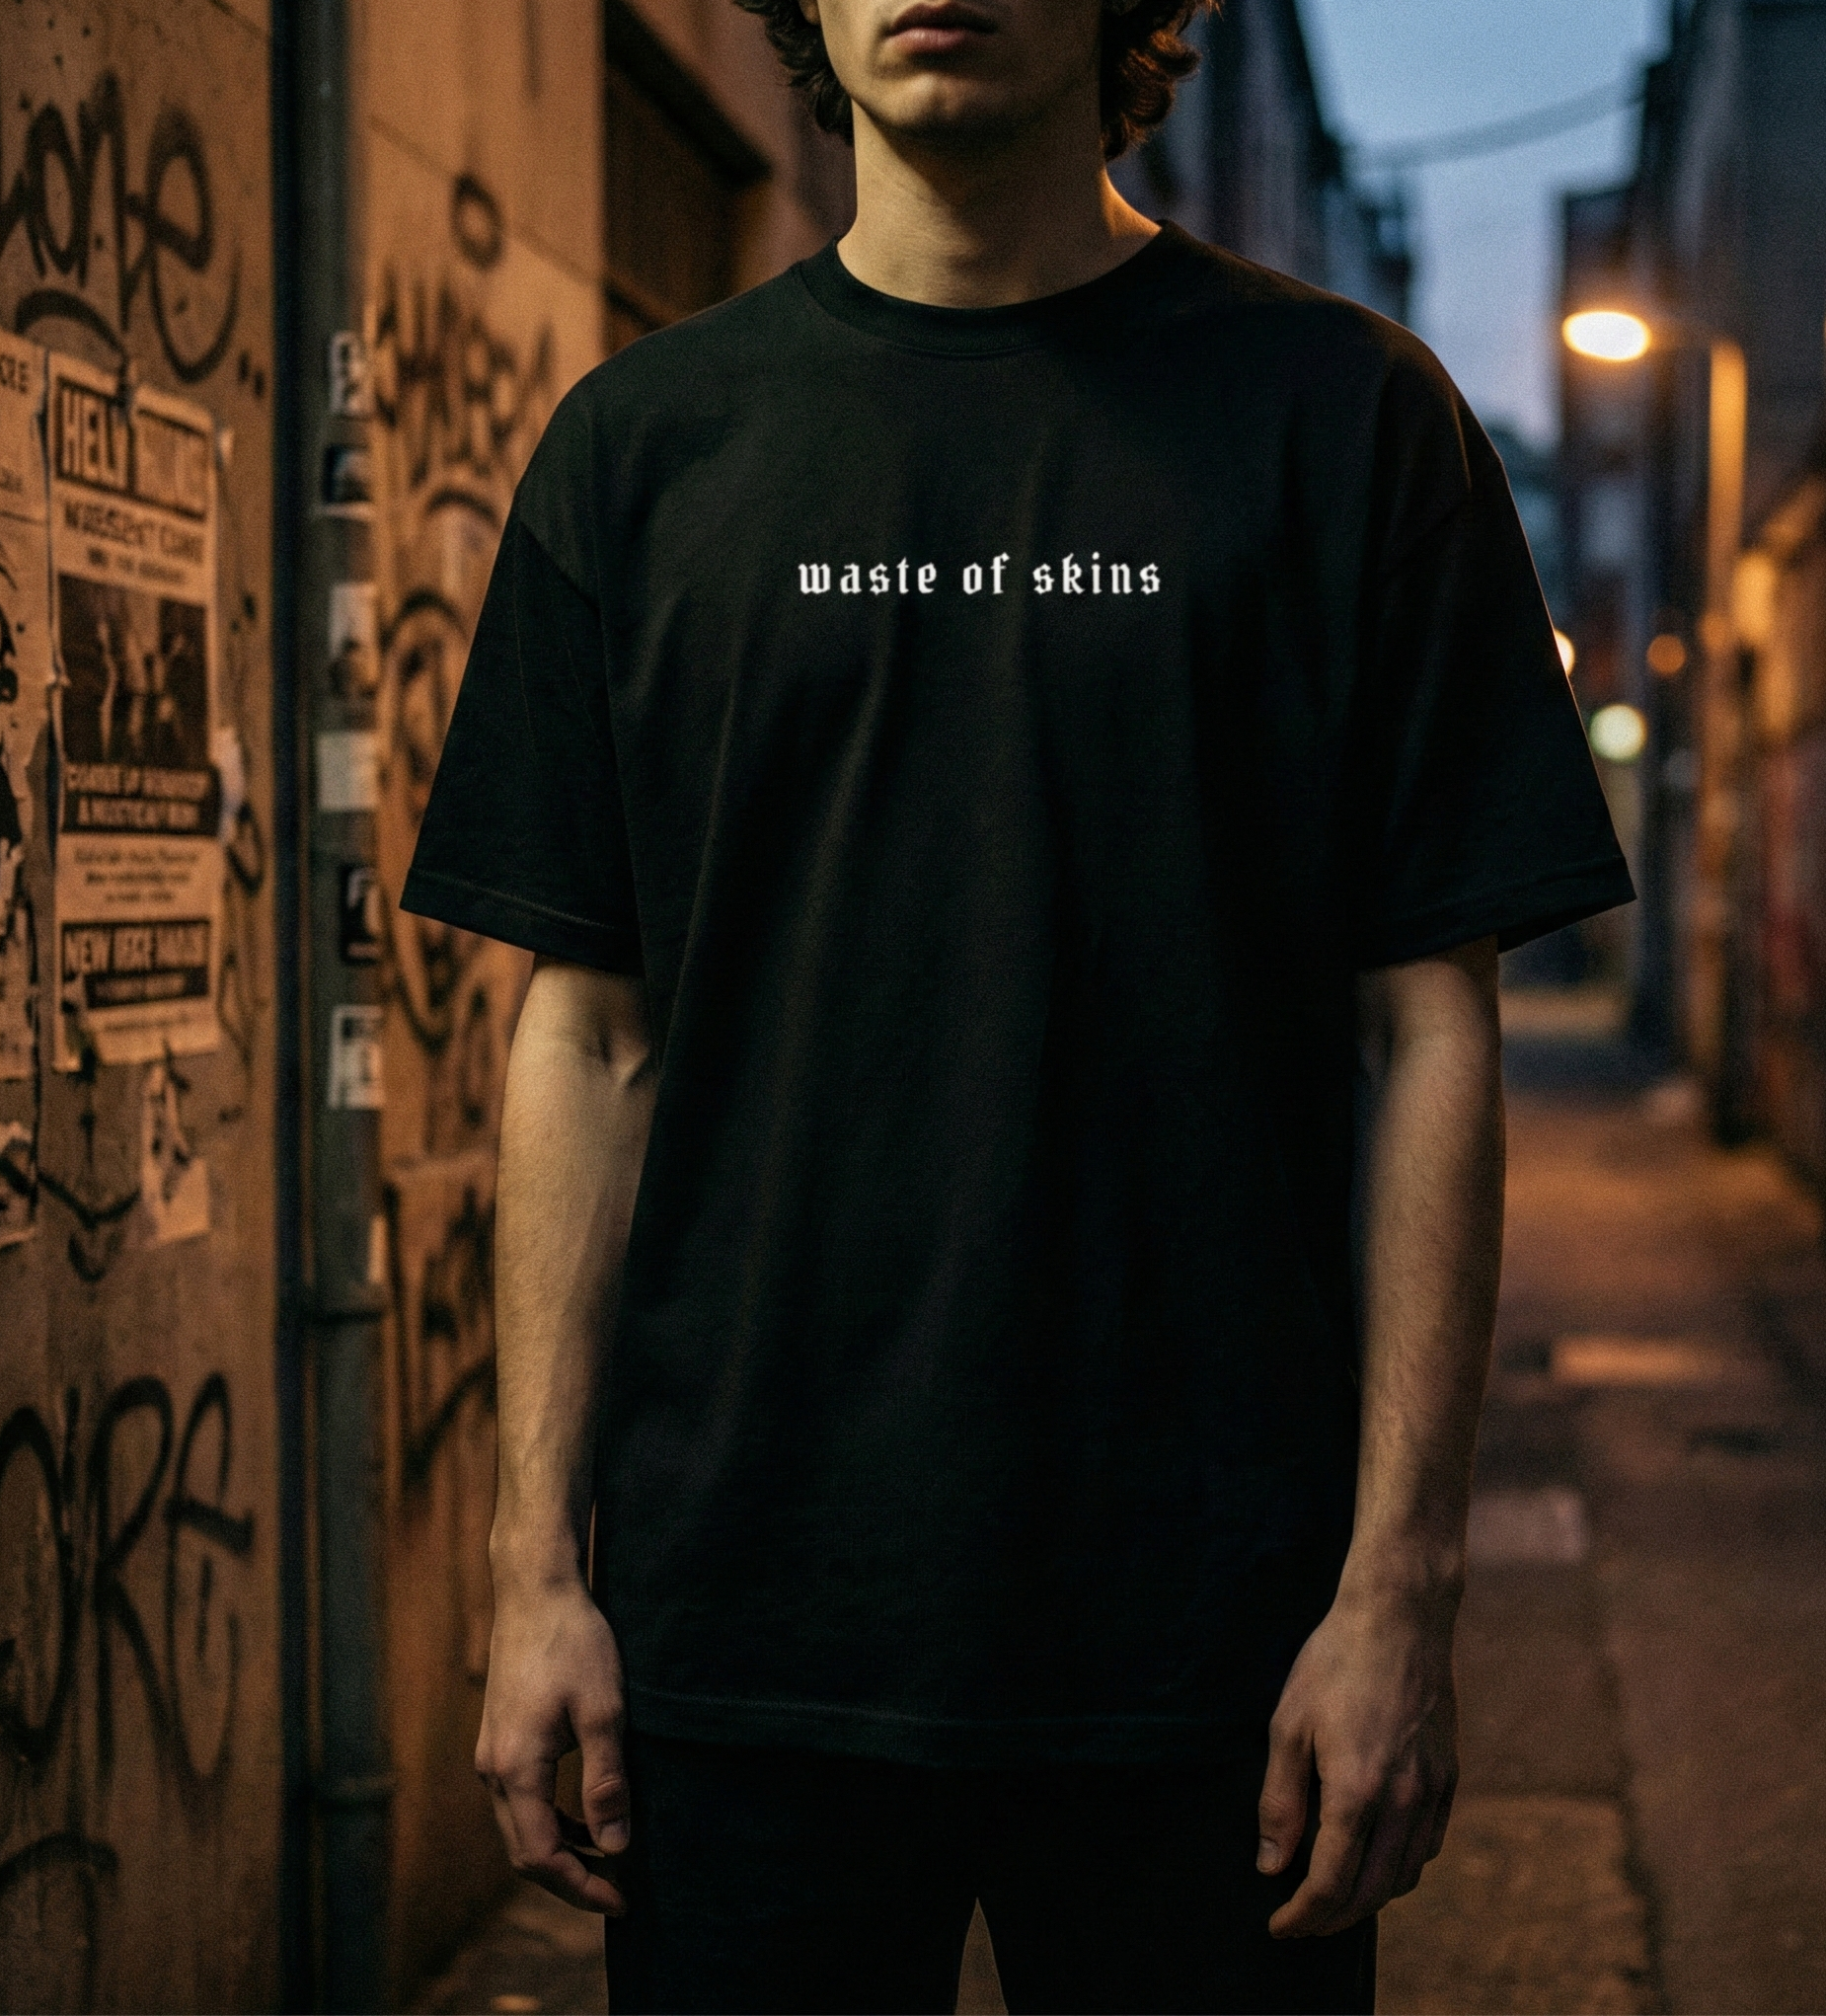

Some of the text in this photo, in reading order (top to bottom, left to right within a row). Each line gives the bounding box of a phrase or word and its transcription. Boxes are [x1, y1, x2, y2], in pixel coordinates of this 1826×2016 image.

[798, 551, 1161, 594] waste of skins
